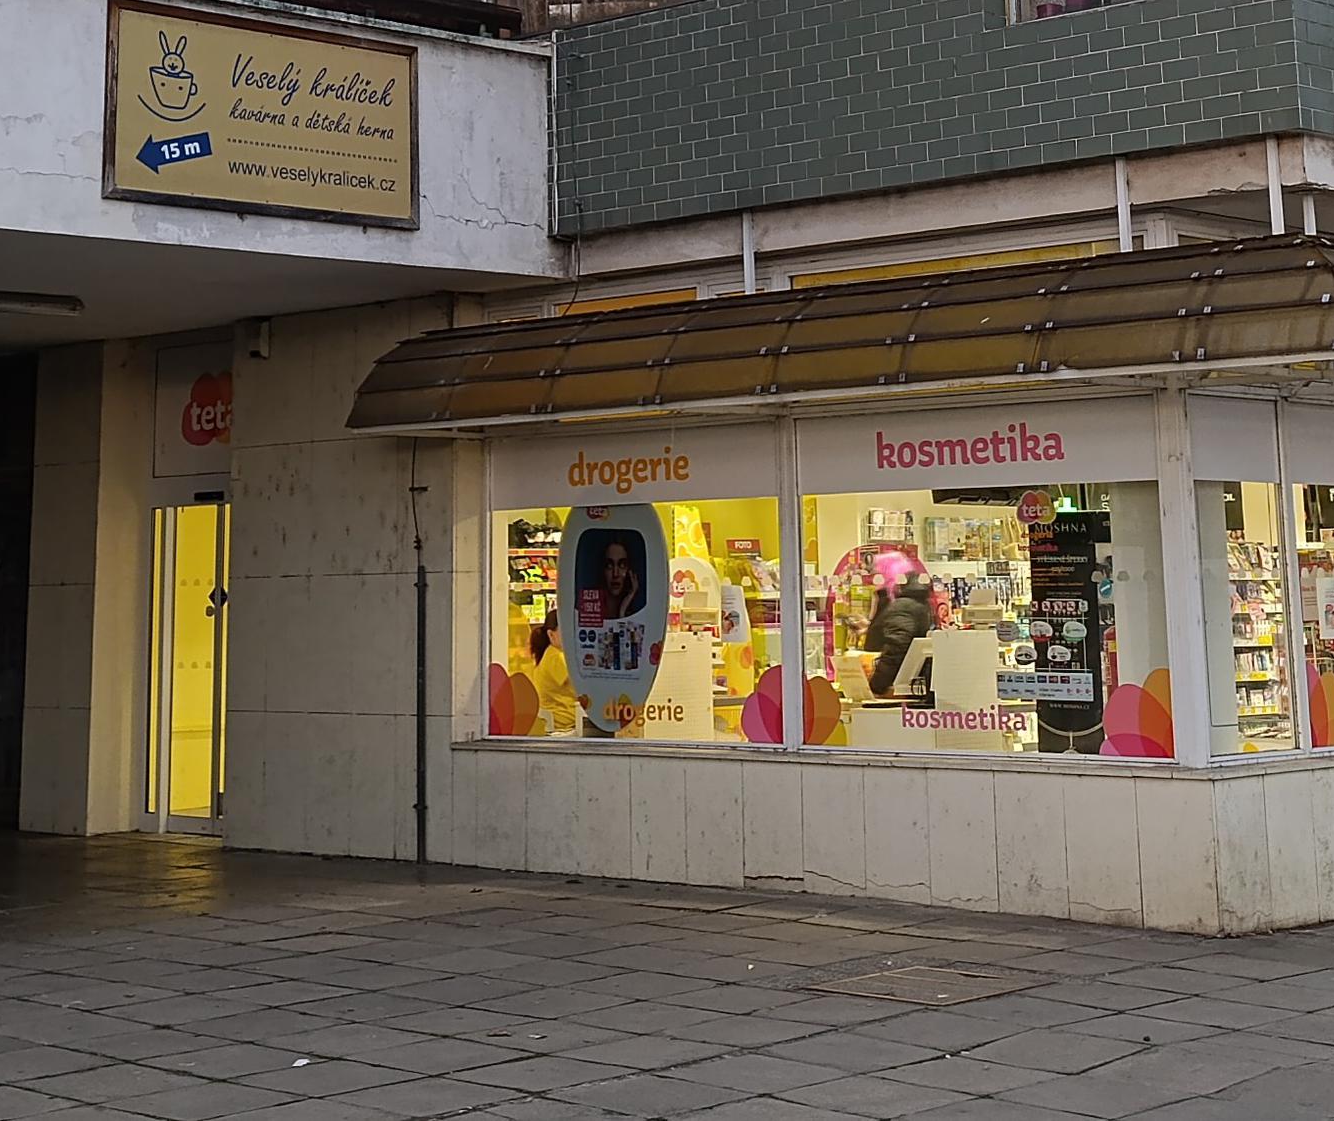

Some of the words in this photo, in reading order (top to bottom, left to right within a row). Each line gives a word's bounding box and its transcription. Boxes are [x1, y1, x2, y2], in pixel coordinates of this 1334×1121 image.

[230, 53, 302, 107] Veselý
[229, 98, 286, 127] kavárna
[291, 116, 302, 127] a
[305, 109, 351, 135] dětská
[356, 114, 395, 141] herna
[160, 140, 181, 160] 15
[183, 139, 201, 156] m
[227, 160, 396, 193] www.veselykralicek.cz
[875, 422, 1066, 469] kosmetika
[568, 446, 691, 494] drogerie
[602, 697, 685, 727] drogerie
[901, 703, 1028, 731] kosmetika
